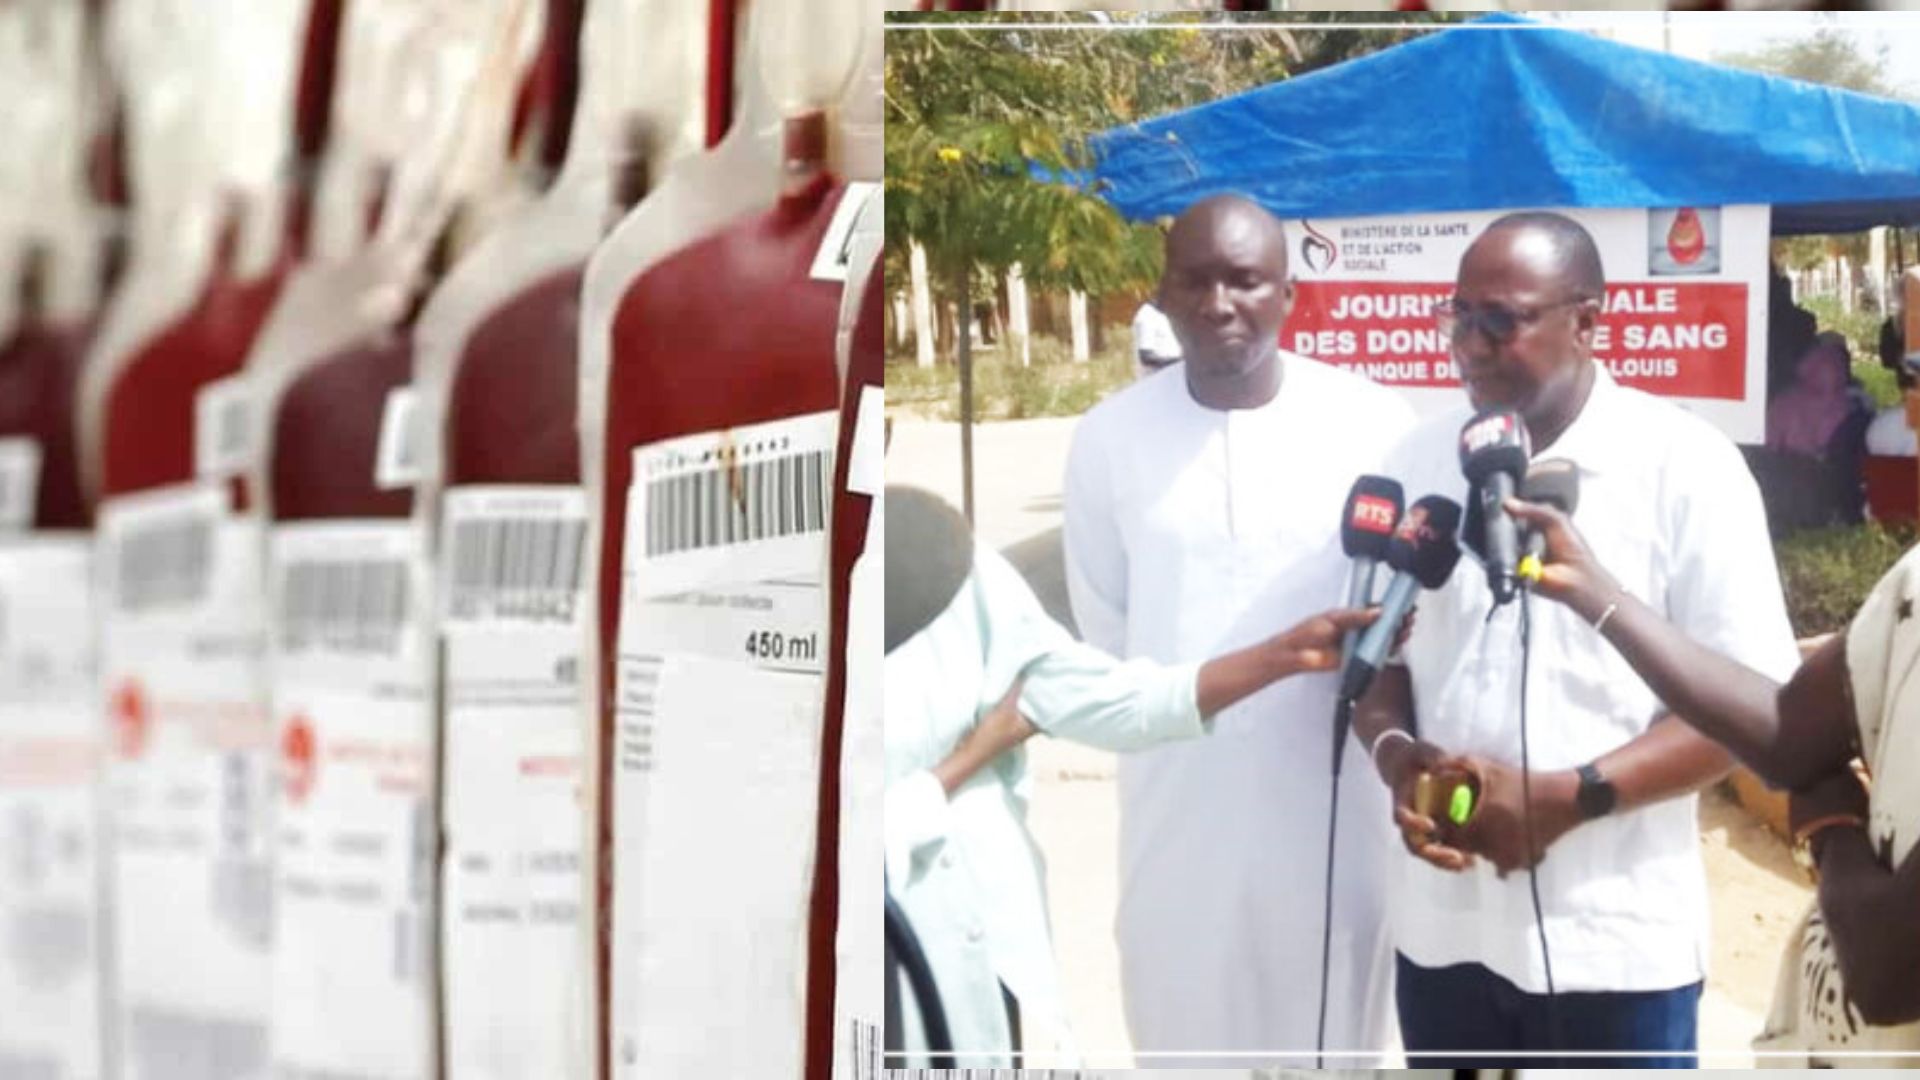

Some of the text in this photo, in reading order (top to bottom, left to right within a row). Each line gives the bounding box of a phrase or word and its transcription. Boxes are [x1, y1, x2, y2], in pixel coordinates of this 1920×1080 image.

[1417, 225, 1430, 235] LA
[1343, 244, 1354, 255] ET
[1358, 243, 1371, 255] DE
[1295, 330, 1357, 355] DES
[1592, 325, 1612, 350] E
[1623, 323, 1728, 349] SANG
[1354, 501, 1393, 526] RTS
[745, 630, 816, 660] 450 ml
